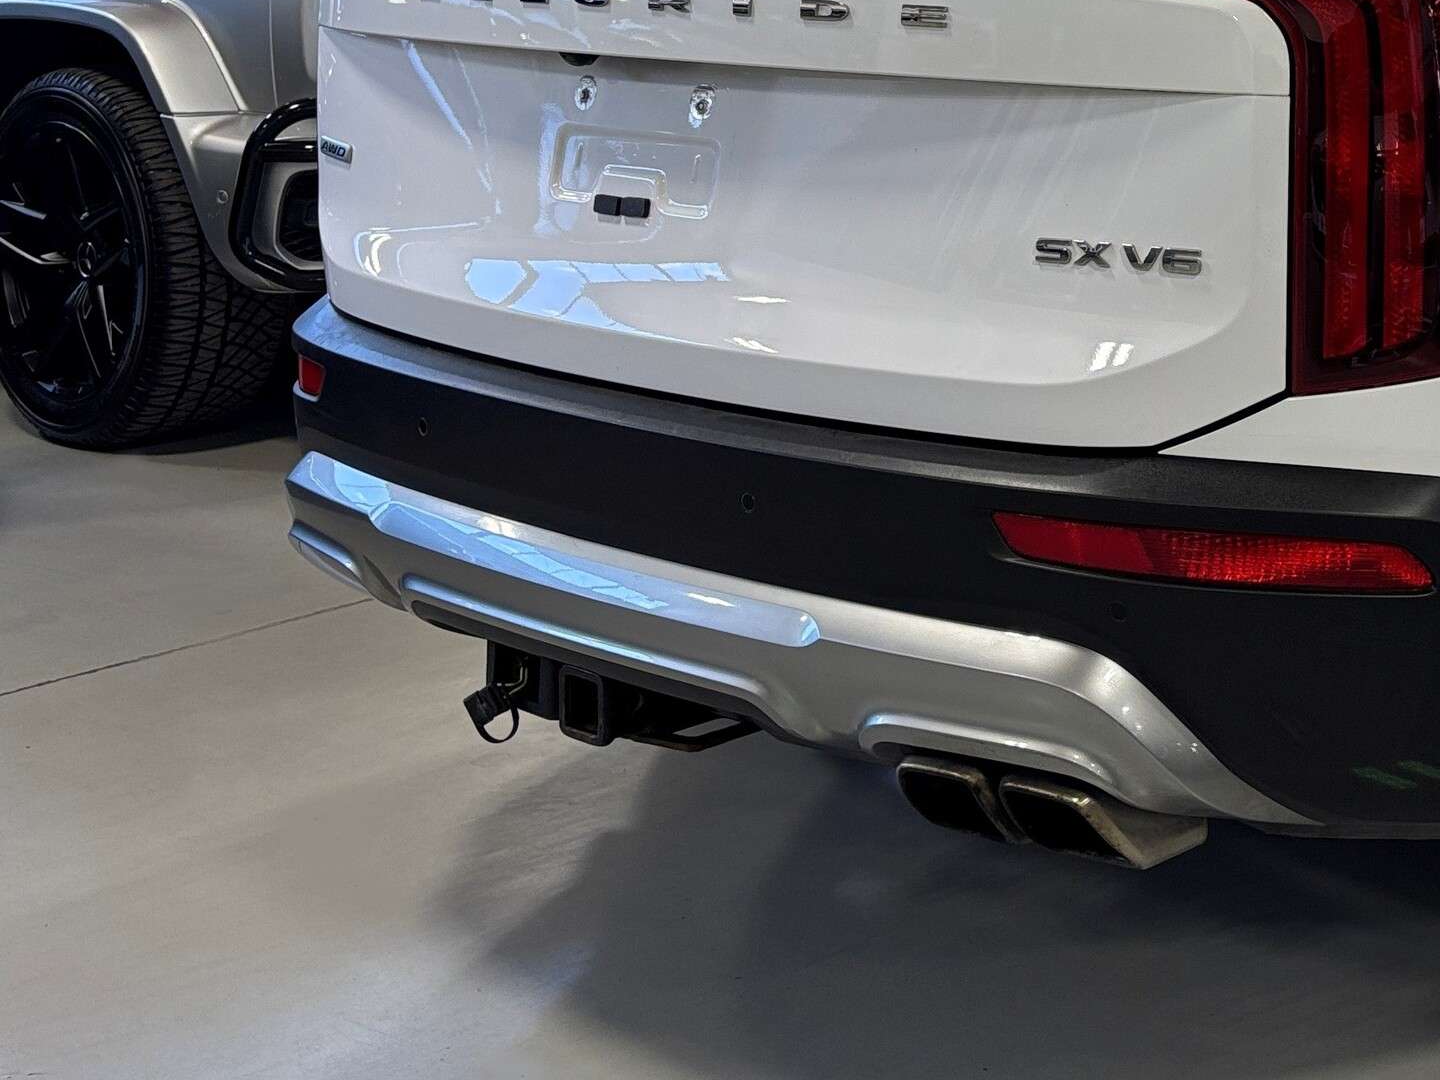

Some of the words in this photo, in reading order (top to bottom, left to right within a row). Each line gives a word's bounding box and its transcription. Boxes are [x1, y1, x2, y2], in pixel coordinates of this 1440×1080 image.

[321, 140, 346, 158] AWD
[1035, 237, 1112, 269] SX
[1121, 242, 1202, 276] V6
